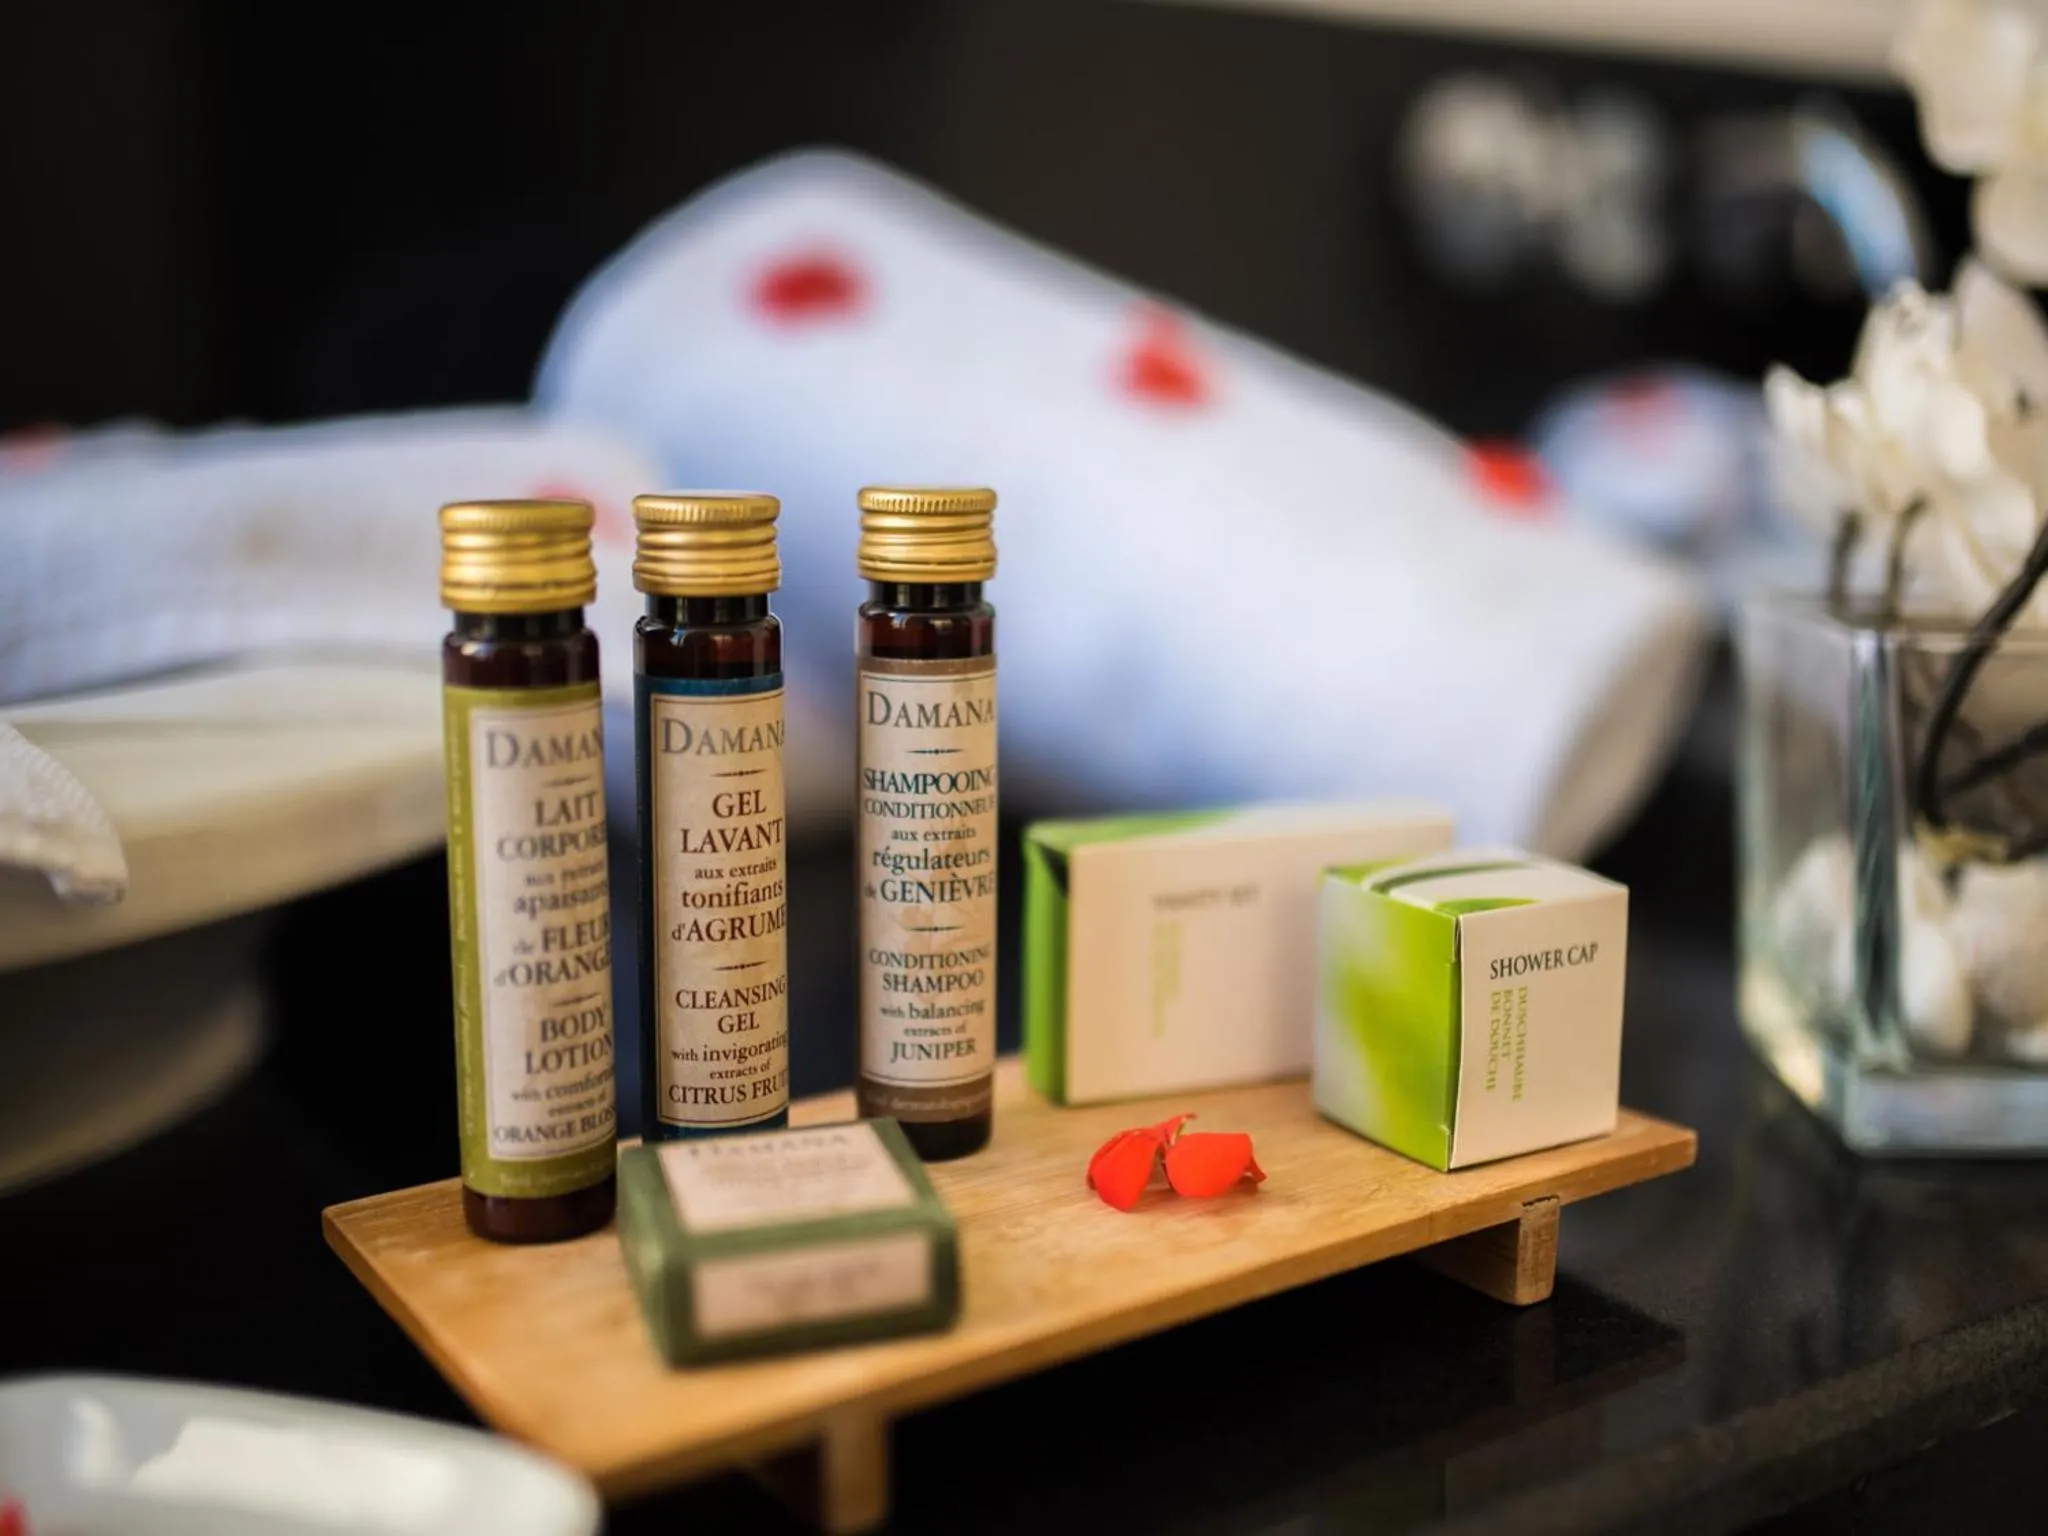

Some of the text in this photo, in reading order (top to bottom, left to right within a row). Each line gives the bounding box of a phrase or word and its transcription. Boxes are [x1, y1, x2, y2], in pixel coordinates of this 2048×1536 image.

[867, 690, 994, 729] DAMANA
[534, 790, 598, 827] LAIT
[711, 789, 767, 819] GEL
[680, 818, 783, 854] LAVANT
[891, 823, 977, 842] aux extraits
[694, 855, 777, 880] aux extraits
[872, 845, 991, 876] régulateurs
[681, 879, 783, 909] tonifiants
[1489, 941, 1599, 981] SHOWER CAP
[675, 973, 787, 1010] CLEANSING
[882, 969, 984, 994] SHAMPOO
[908, 999, 985, 1021] balancing
[1491, 991, 1501, 1012] DE
[540, 1005, 607, 1043] BODY
[717, 1011, 760, 1035] GEL
[1501, 988, 1513, 1059] BONNET
[671, 1048, 699, 1062] with
[889, 1037, 976, 1064] JUNIPER
[709, 1057, 772, 1080] extracts of
[668, 1083, 747, 1105] CITRUS
[493, 1119, 577, 1143] ORANGE
